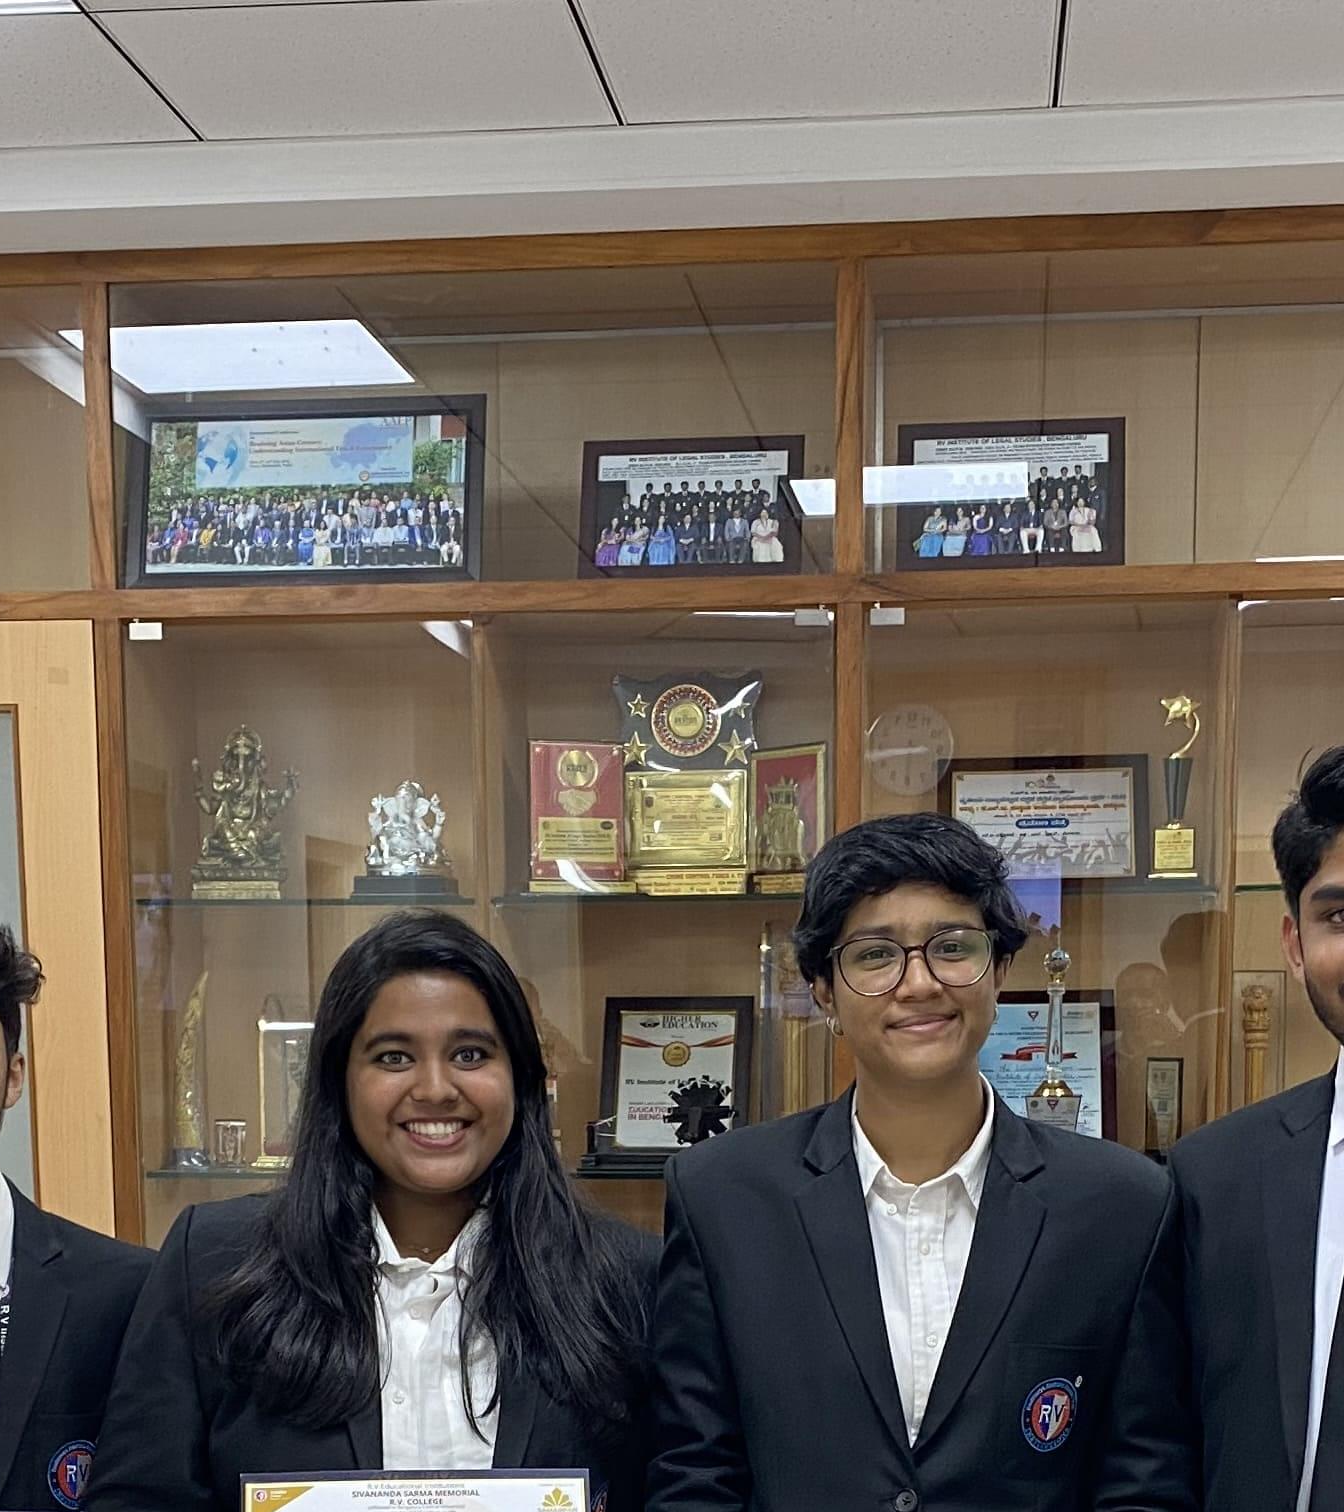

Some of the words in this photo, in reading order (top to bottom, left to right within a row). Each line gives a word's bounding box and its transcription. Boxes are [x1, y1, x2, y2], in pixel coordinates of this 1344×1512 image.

[661, 1020, 718, 1029] EDUCATION
[1039, 1404, 1066, 1424] RV
[65, 1463, 88, 1483] RV
